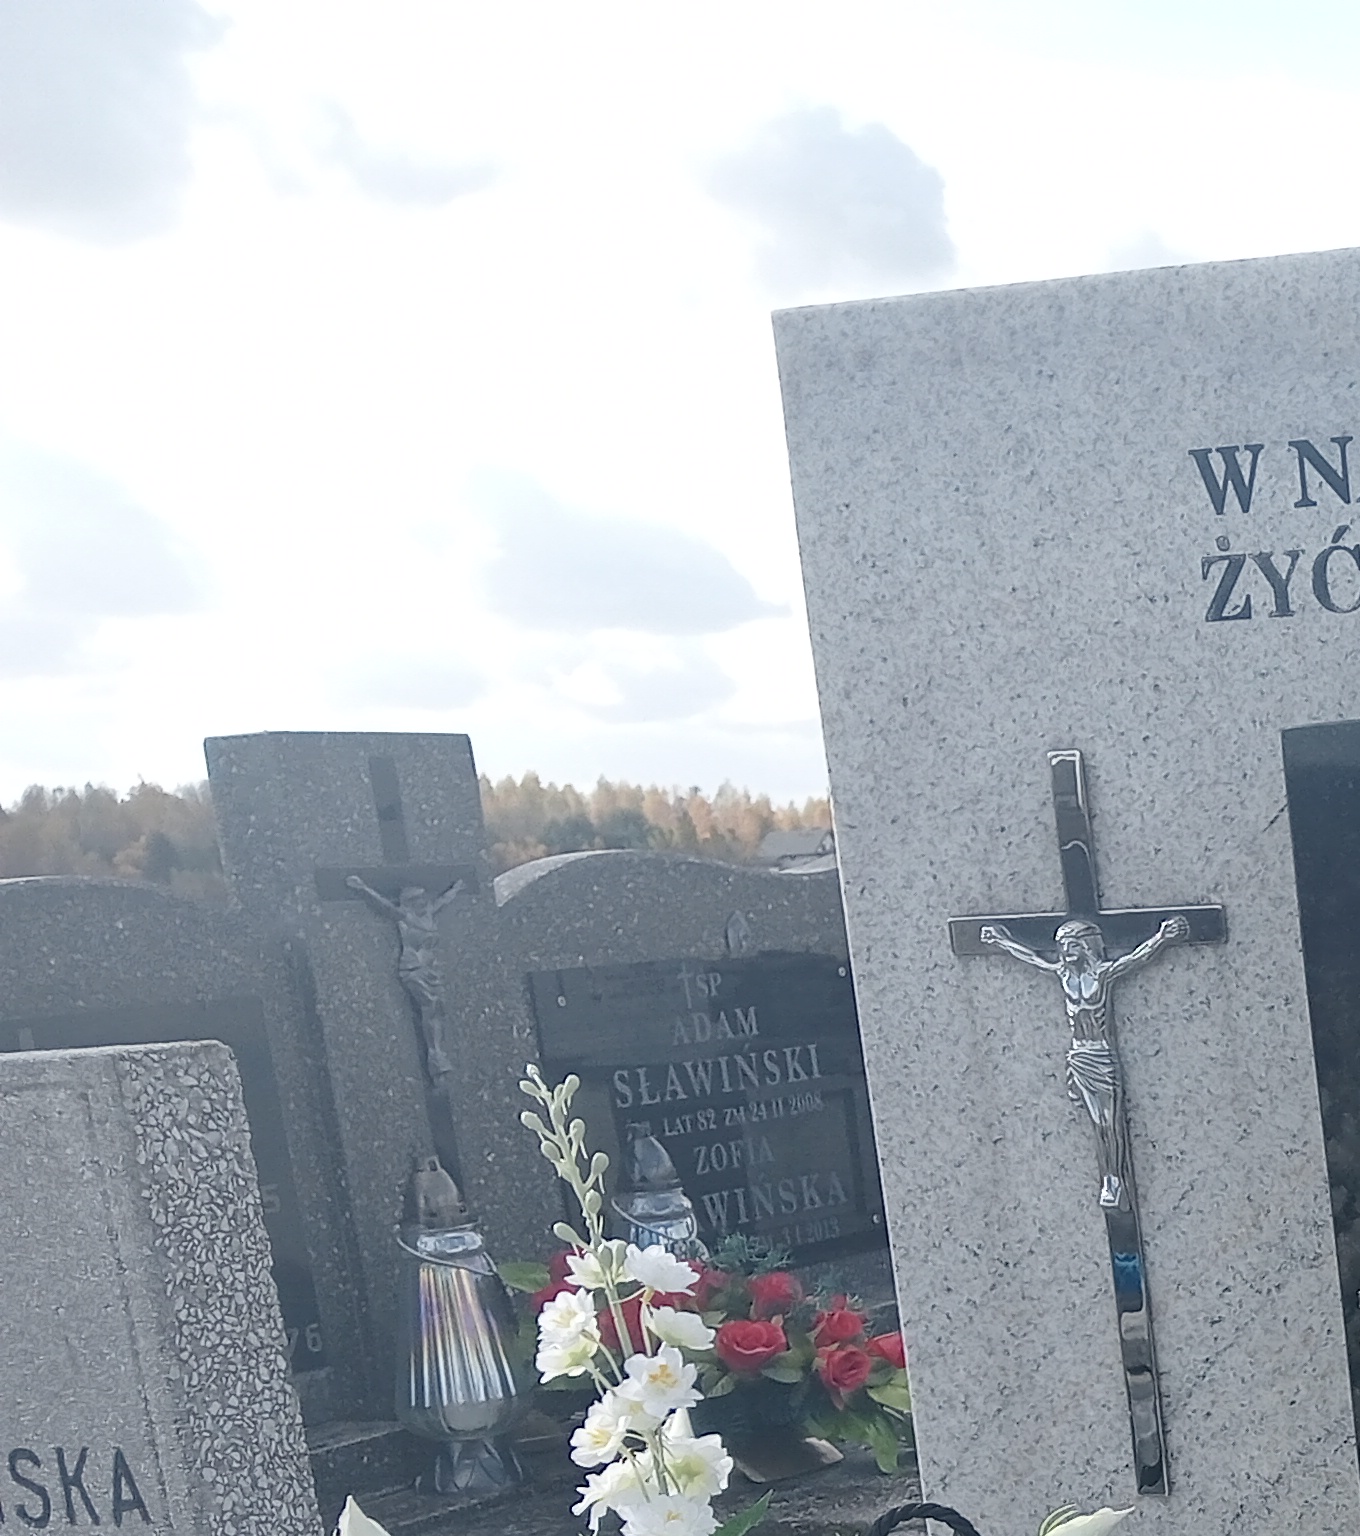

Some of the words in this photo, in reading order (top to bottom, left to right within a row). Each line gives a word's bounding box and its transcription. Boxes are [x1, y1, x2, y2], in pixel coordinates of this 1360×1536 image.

[1188, 443, 1264, 515] W
[672, 1006, 760, 1046] ADAM
[613, 1043, 823, 1108] SŁAWIŃSKI
[663, 1114, 694, 1136] LAT
[694, 1135, 776, 1176] ZOFIA
[701, 1170, 850, 1232] WIŃSKA
[0, 1446, 151, 1529] SKA
